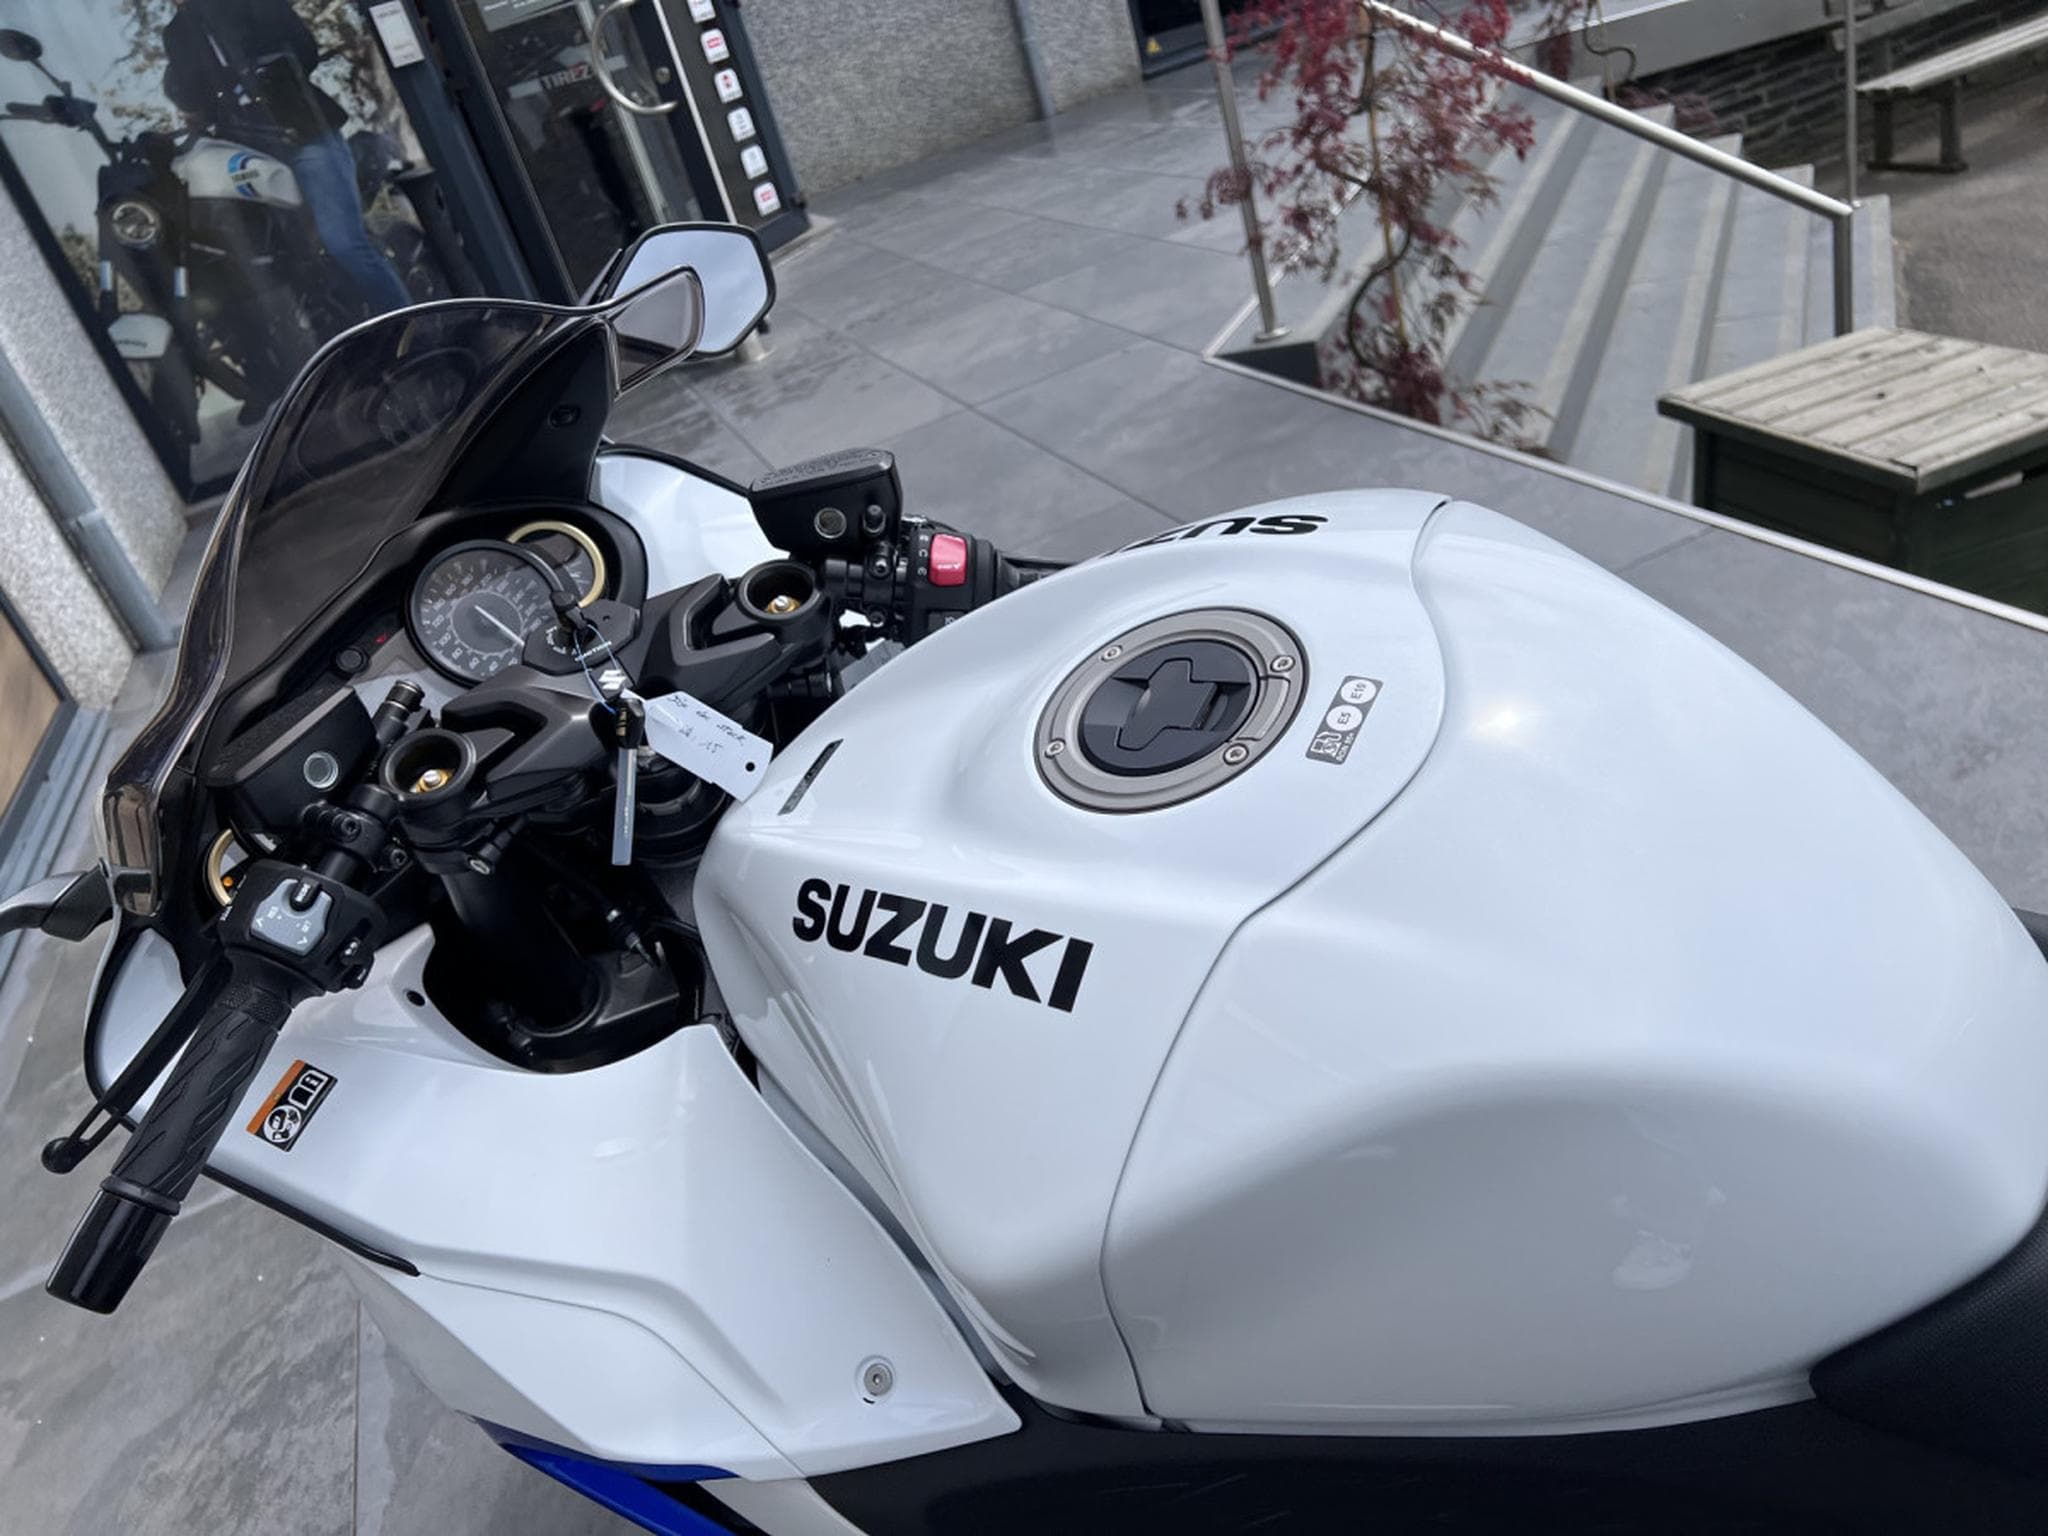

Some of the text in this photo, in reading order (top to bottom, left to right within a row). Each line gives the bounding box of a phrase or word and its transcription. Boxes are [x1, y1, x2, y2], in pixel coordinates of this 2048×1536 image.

[1350, 682, 1367, 700] E10
[1337, 711, 1352, 725] E5
[792, 877, 1095, 1013] SUZUKI
